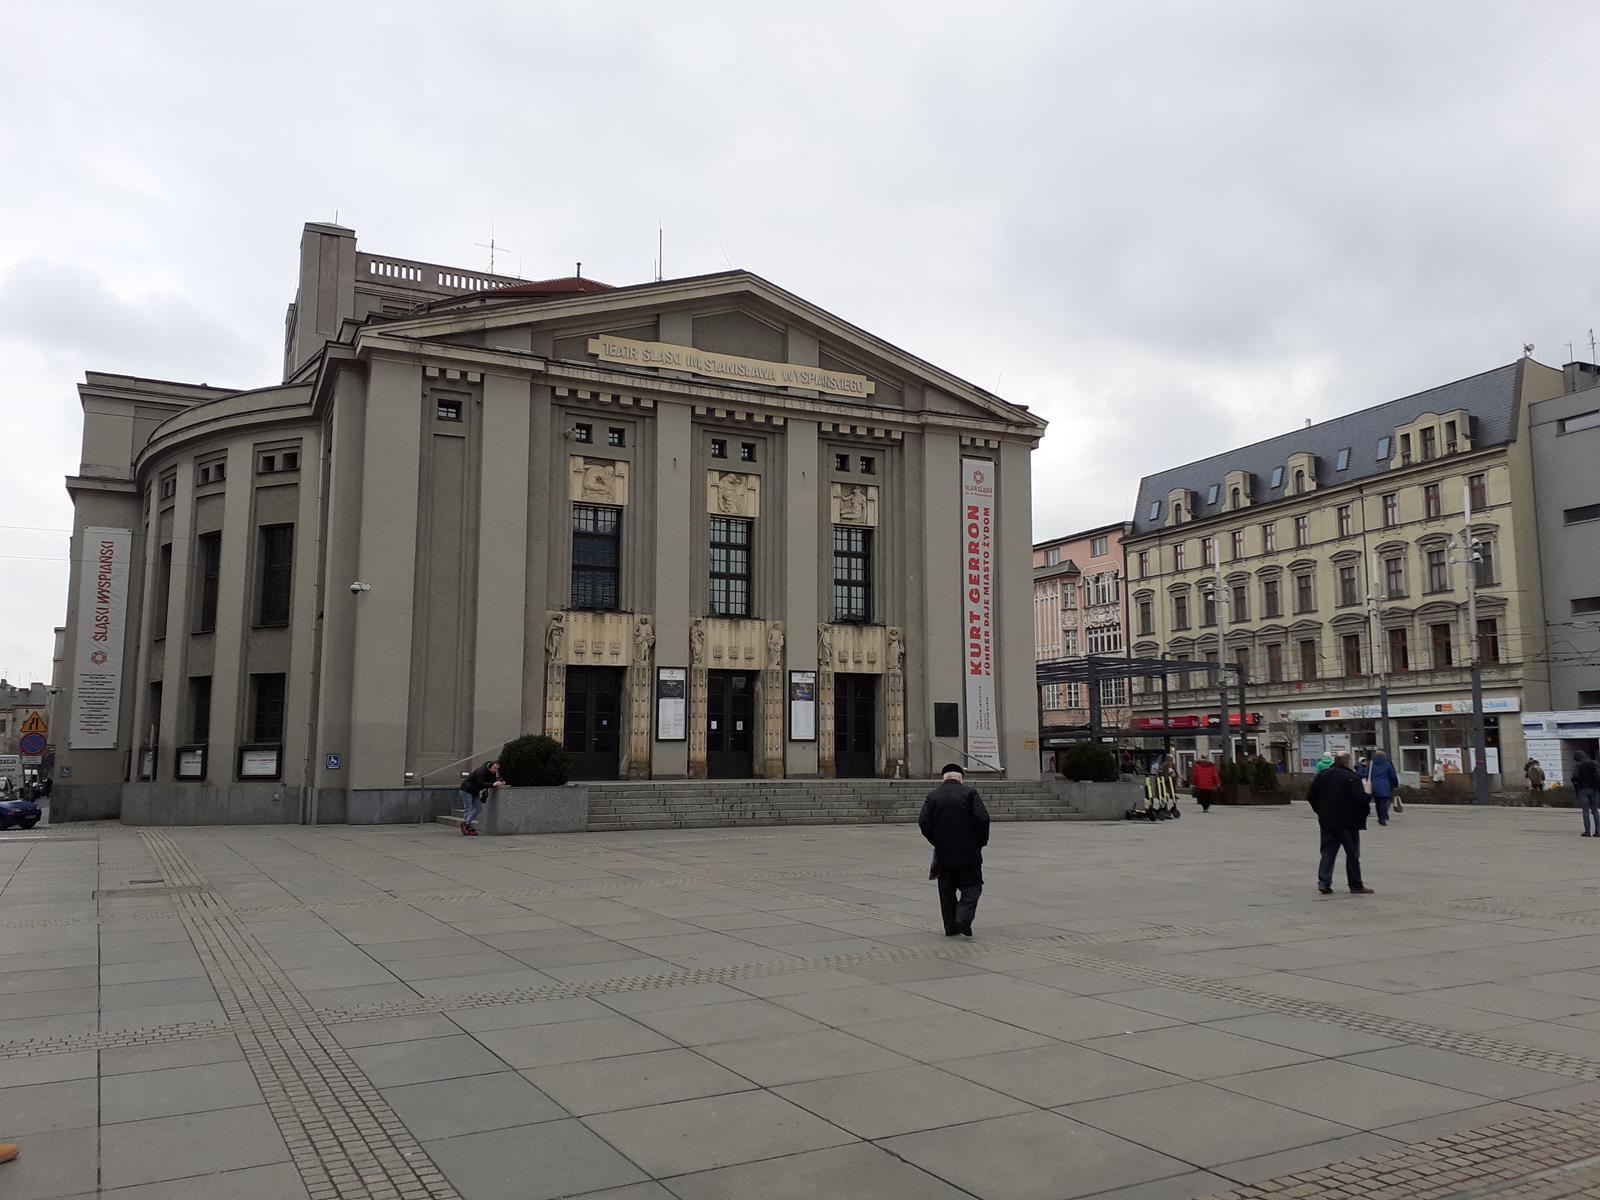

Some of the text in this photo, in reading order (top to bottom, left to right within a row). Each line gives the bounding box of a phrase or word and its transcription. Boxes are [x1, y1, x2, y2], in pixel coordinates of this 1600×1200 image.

[602, 342, 637, 360] TEATR
[704, 359, 776, 381] STANISŁAWA
[967, 505, 981, 604] GERRON
[981, 506, 990, 548] ŻYDOM
[92, 541, 114, 642] ŚLĄSKI WYSPIAŃSKI
[969, 610, 982, 676] KURT
